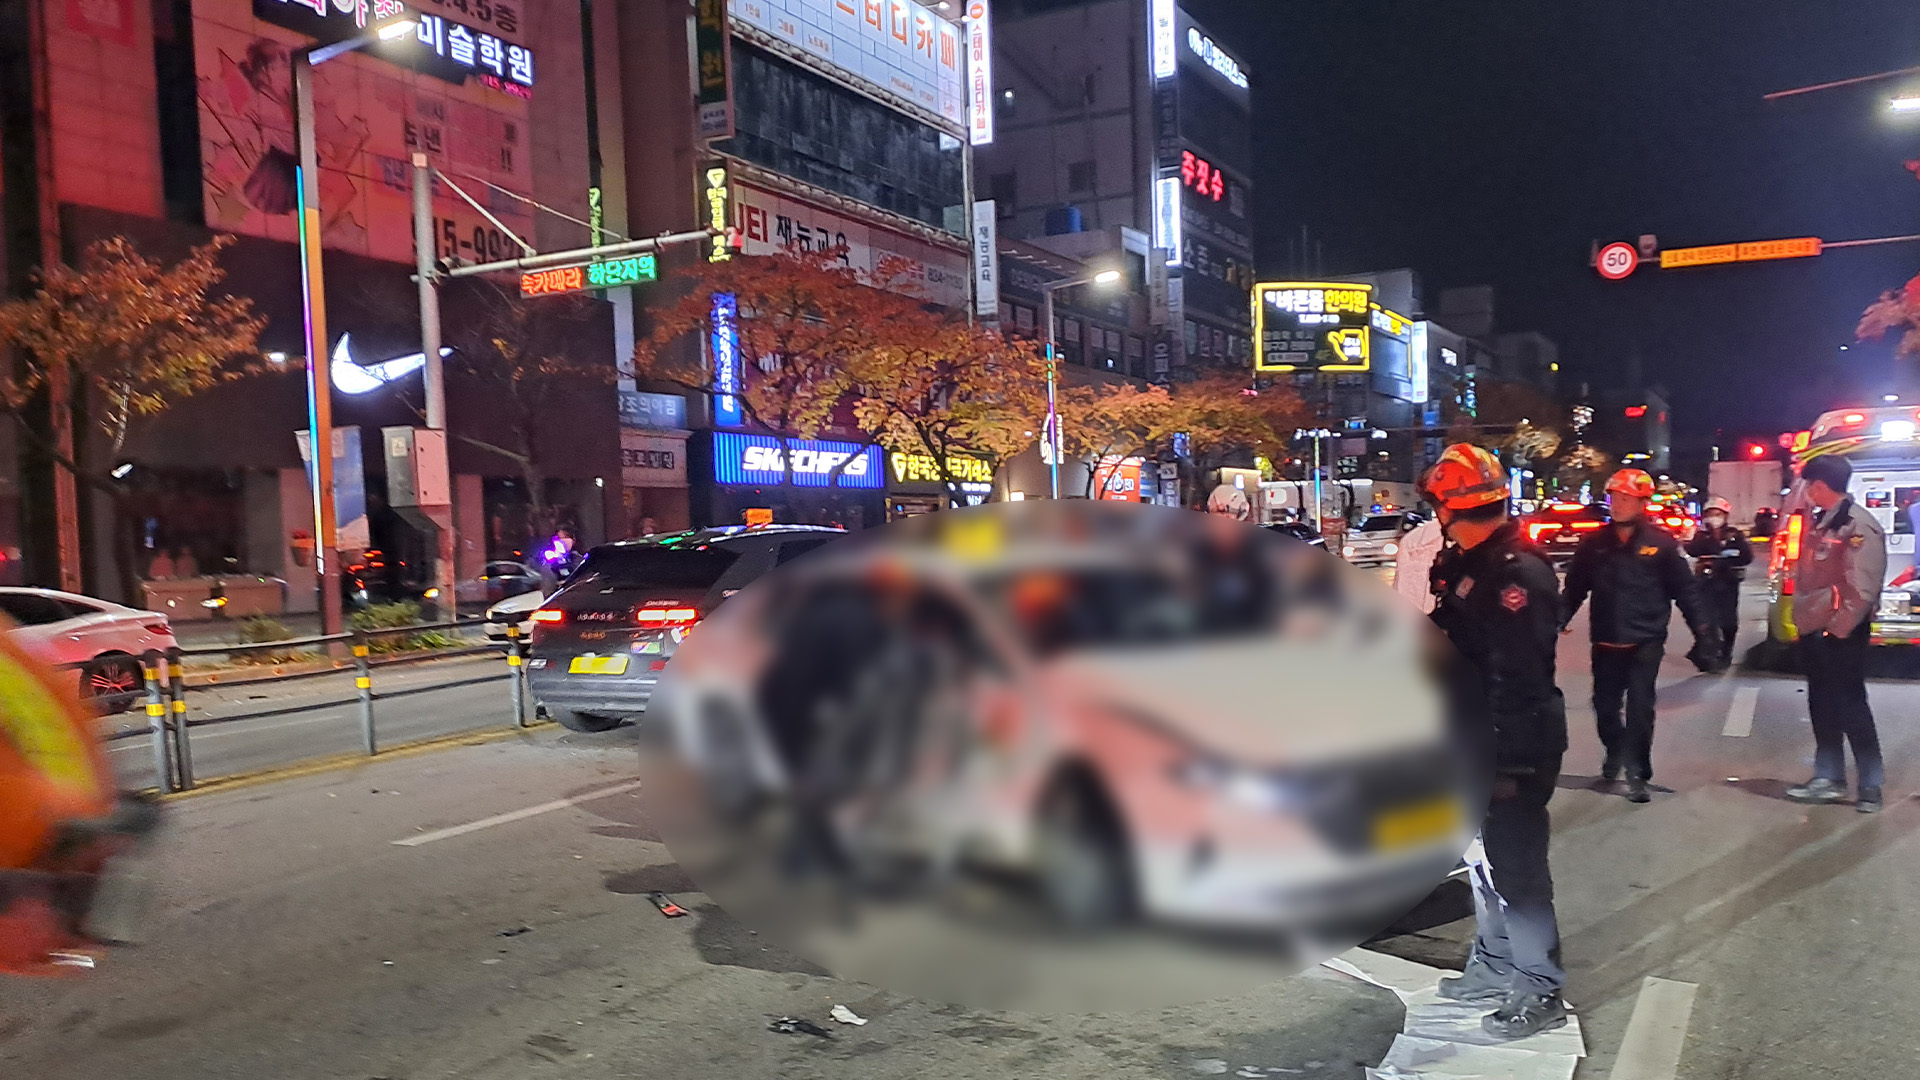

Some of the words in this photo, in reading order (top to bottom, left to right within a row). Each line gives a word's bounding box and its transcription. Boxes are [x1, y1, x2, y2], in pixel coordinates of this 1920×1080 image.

[417, 14, 533, 86] 미술학원
[836, 0, 955, 71] 터디카페
[973, 24, 983, 61] 스테이
[734, 203, 768, 243] JEI
[588, 254, 656, 285] 하단지역
[1606, 251, 1628, 267] 50
[742, 446, 869, 475] SKCHES
